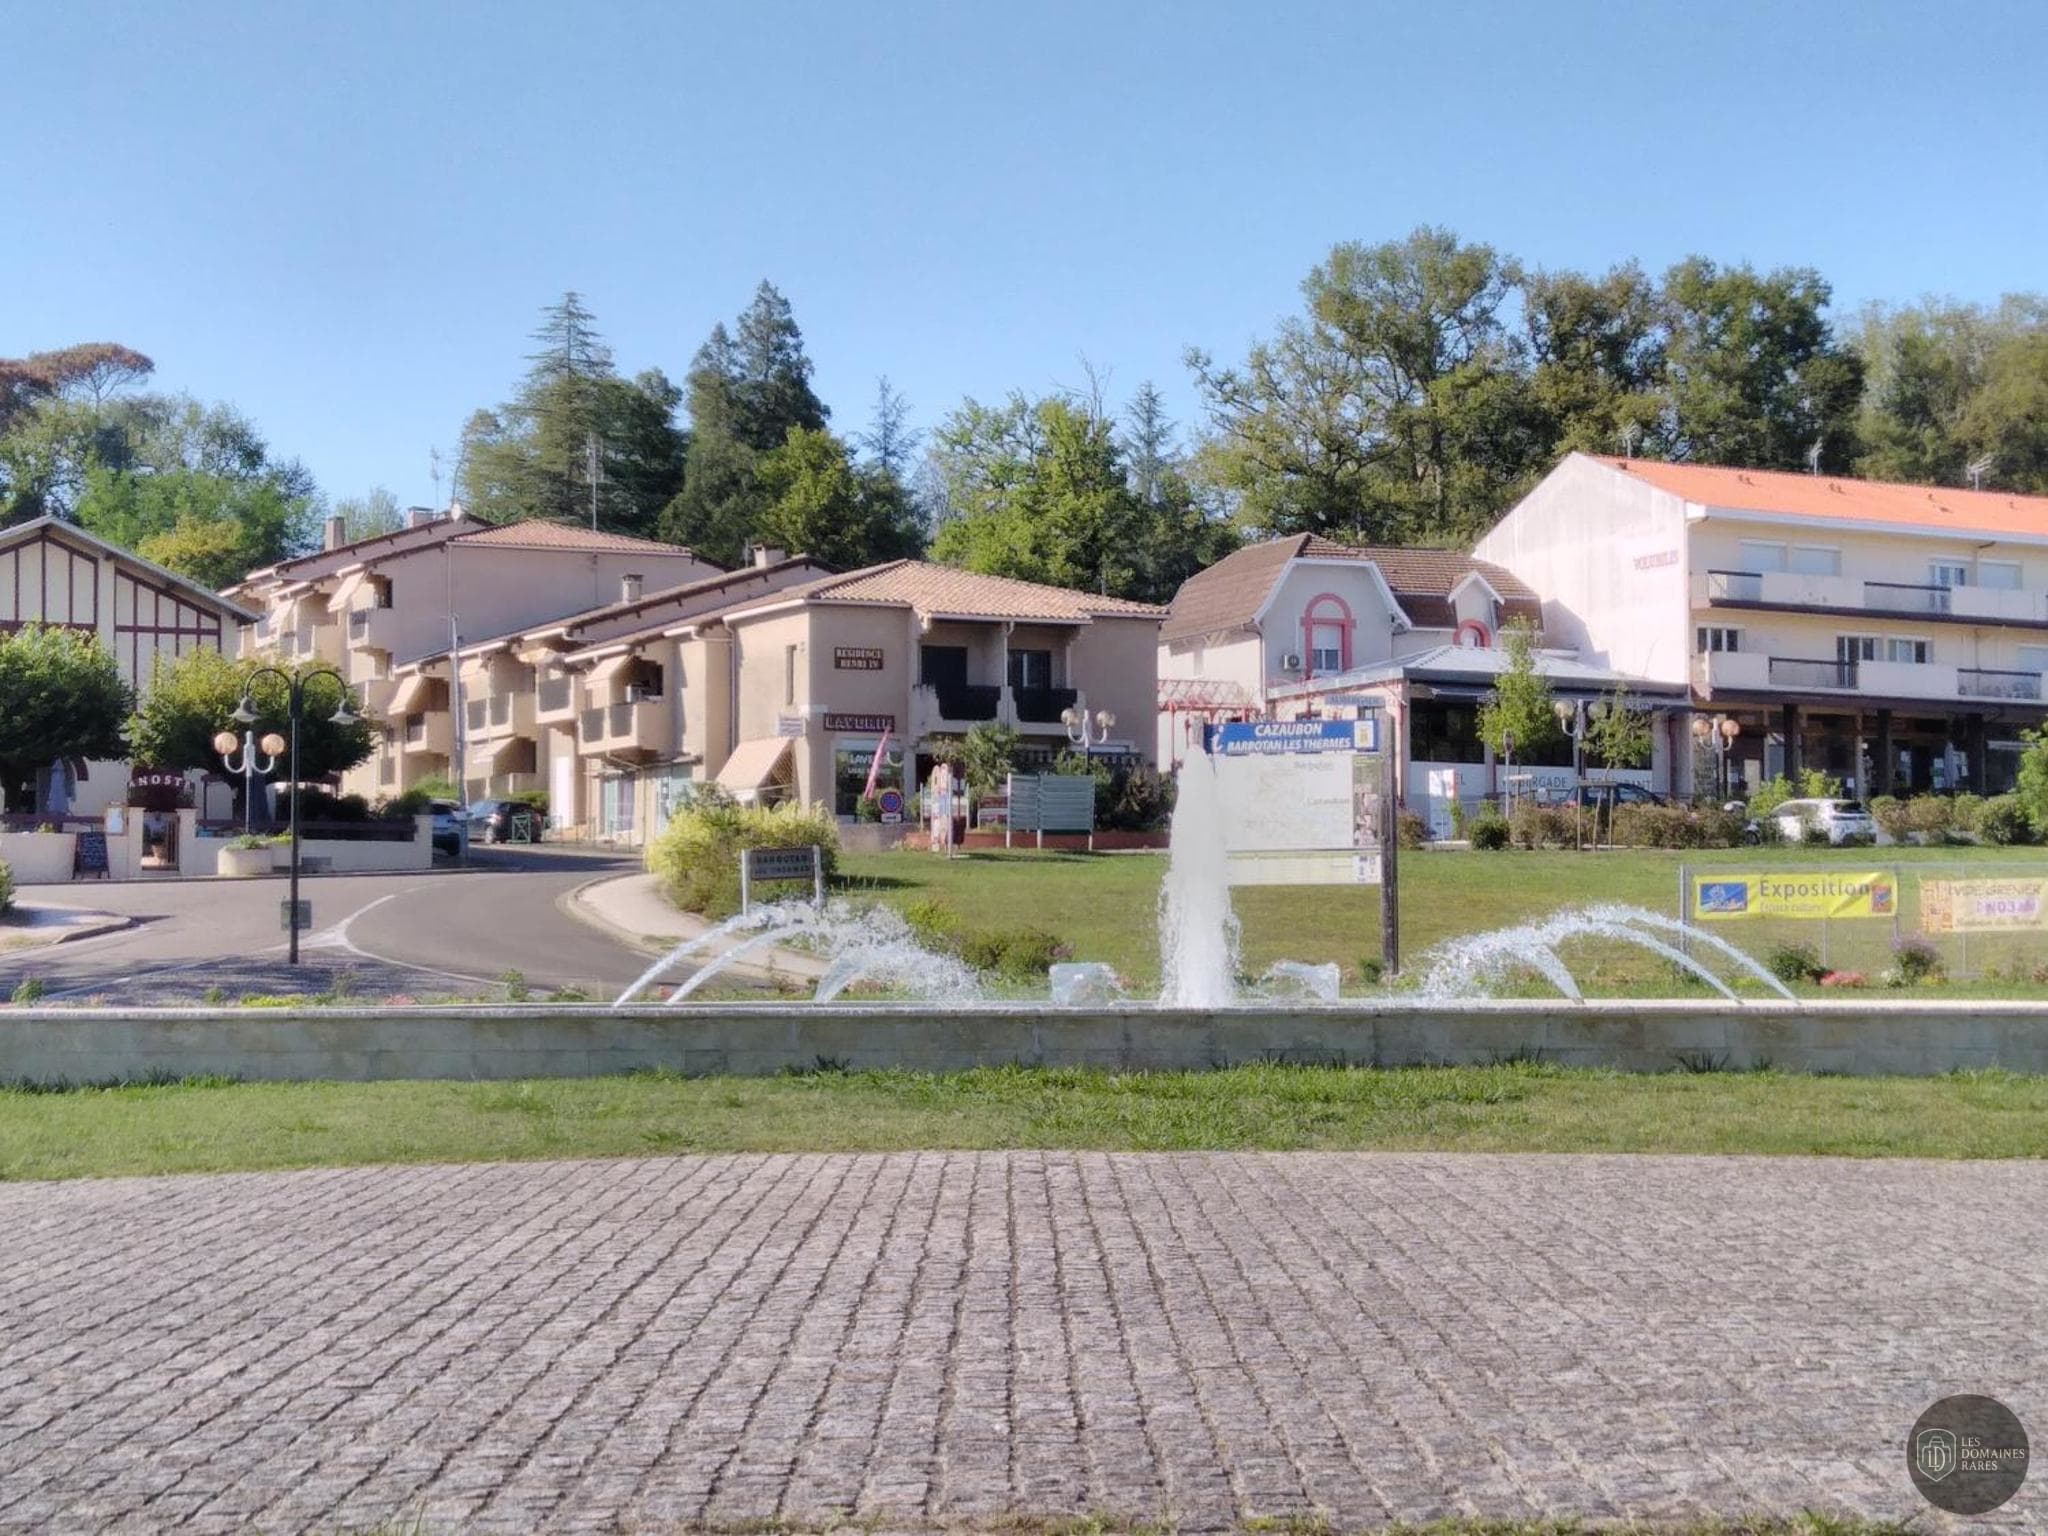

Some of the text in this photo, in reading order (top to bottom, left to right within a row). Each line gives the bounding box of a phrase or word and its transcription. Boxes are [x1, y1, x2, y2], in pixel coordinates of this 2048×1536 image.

[1254, 723, 1323, 737] CAZAUBON
[1227, 737, 1351, 752] BARBOTAN LES THERMES
[1760, 880, 1870, 900] Exposition
